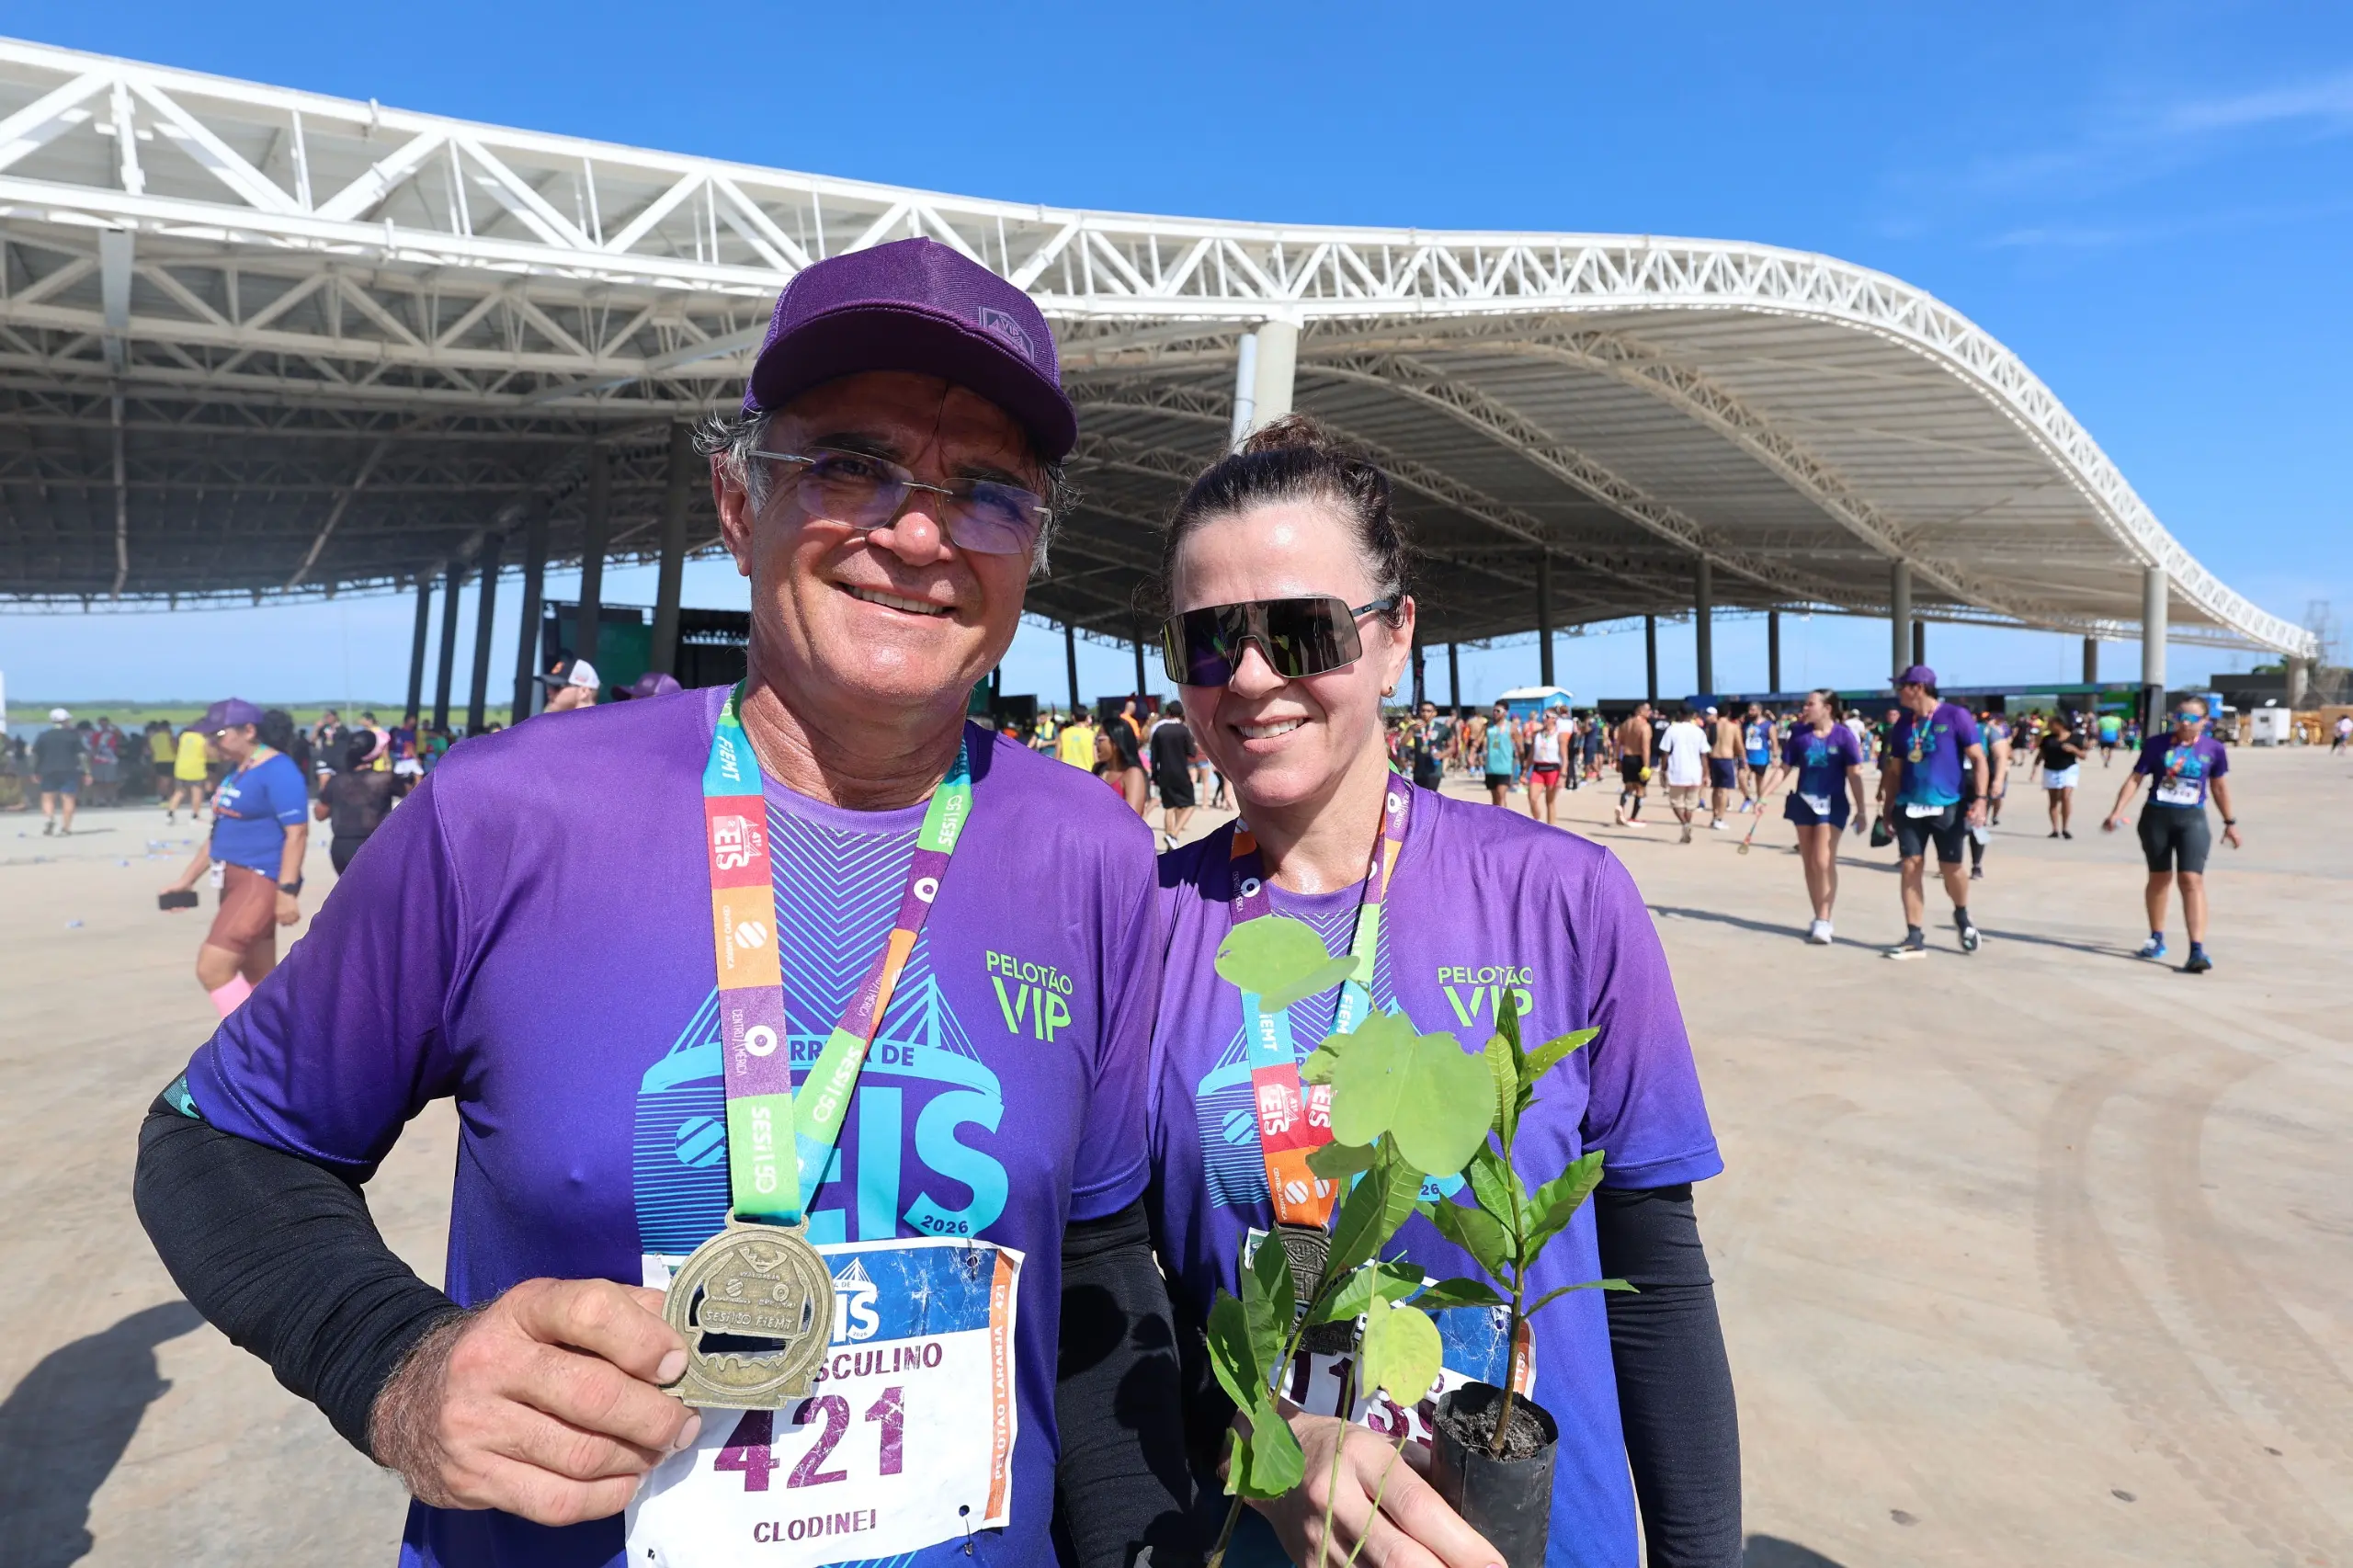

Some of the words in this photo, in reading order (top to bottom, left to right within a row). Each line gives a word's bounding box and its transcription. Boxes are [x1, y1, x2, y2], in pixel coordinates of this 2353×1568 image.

[985, 949, 1074, 995] PELOTÃO
[1437, 965, 1534, 986] PELOTÃO
[991, 975, 1072, 1043] VIP
[1442, 984, 1534, 1028] VIP
[881, 1043, 915, 1067] DE
[1420, 1183, 1441, 1196] 26
[920, 1214, 969, 1234] 2026
[995, 1284, 1006, 1309] 421
[813, 1342, 943, 1382] SCULINO
[993, 1324, 1006, 1400] LARANJA
[713, 1385, 905, 1493] 421
[753, 1508, 878, 1544] CLODINEI
